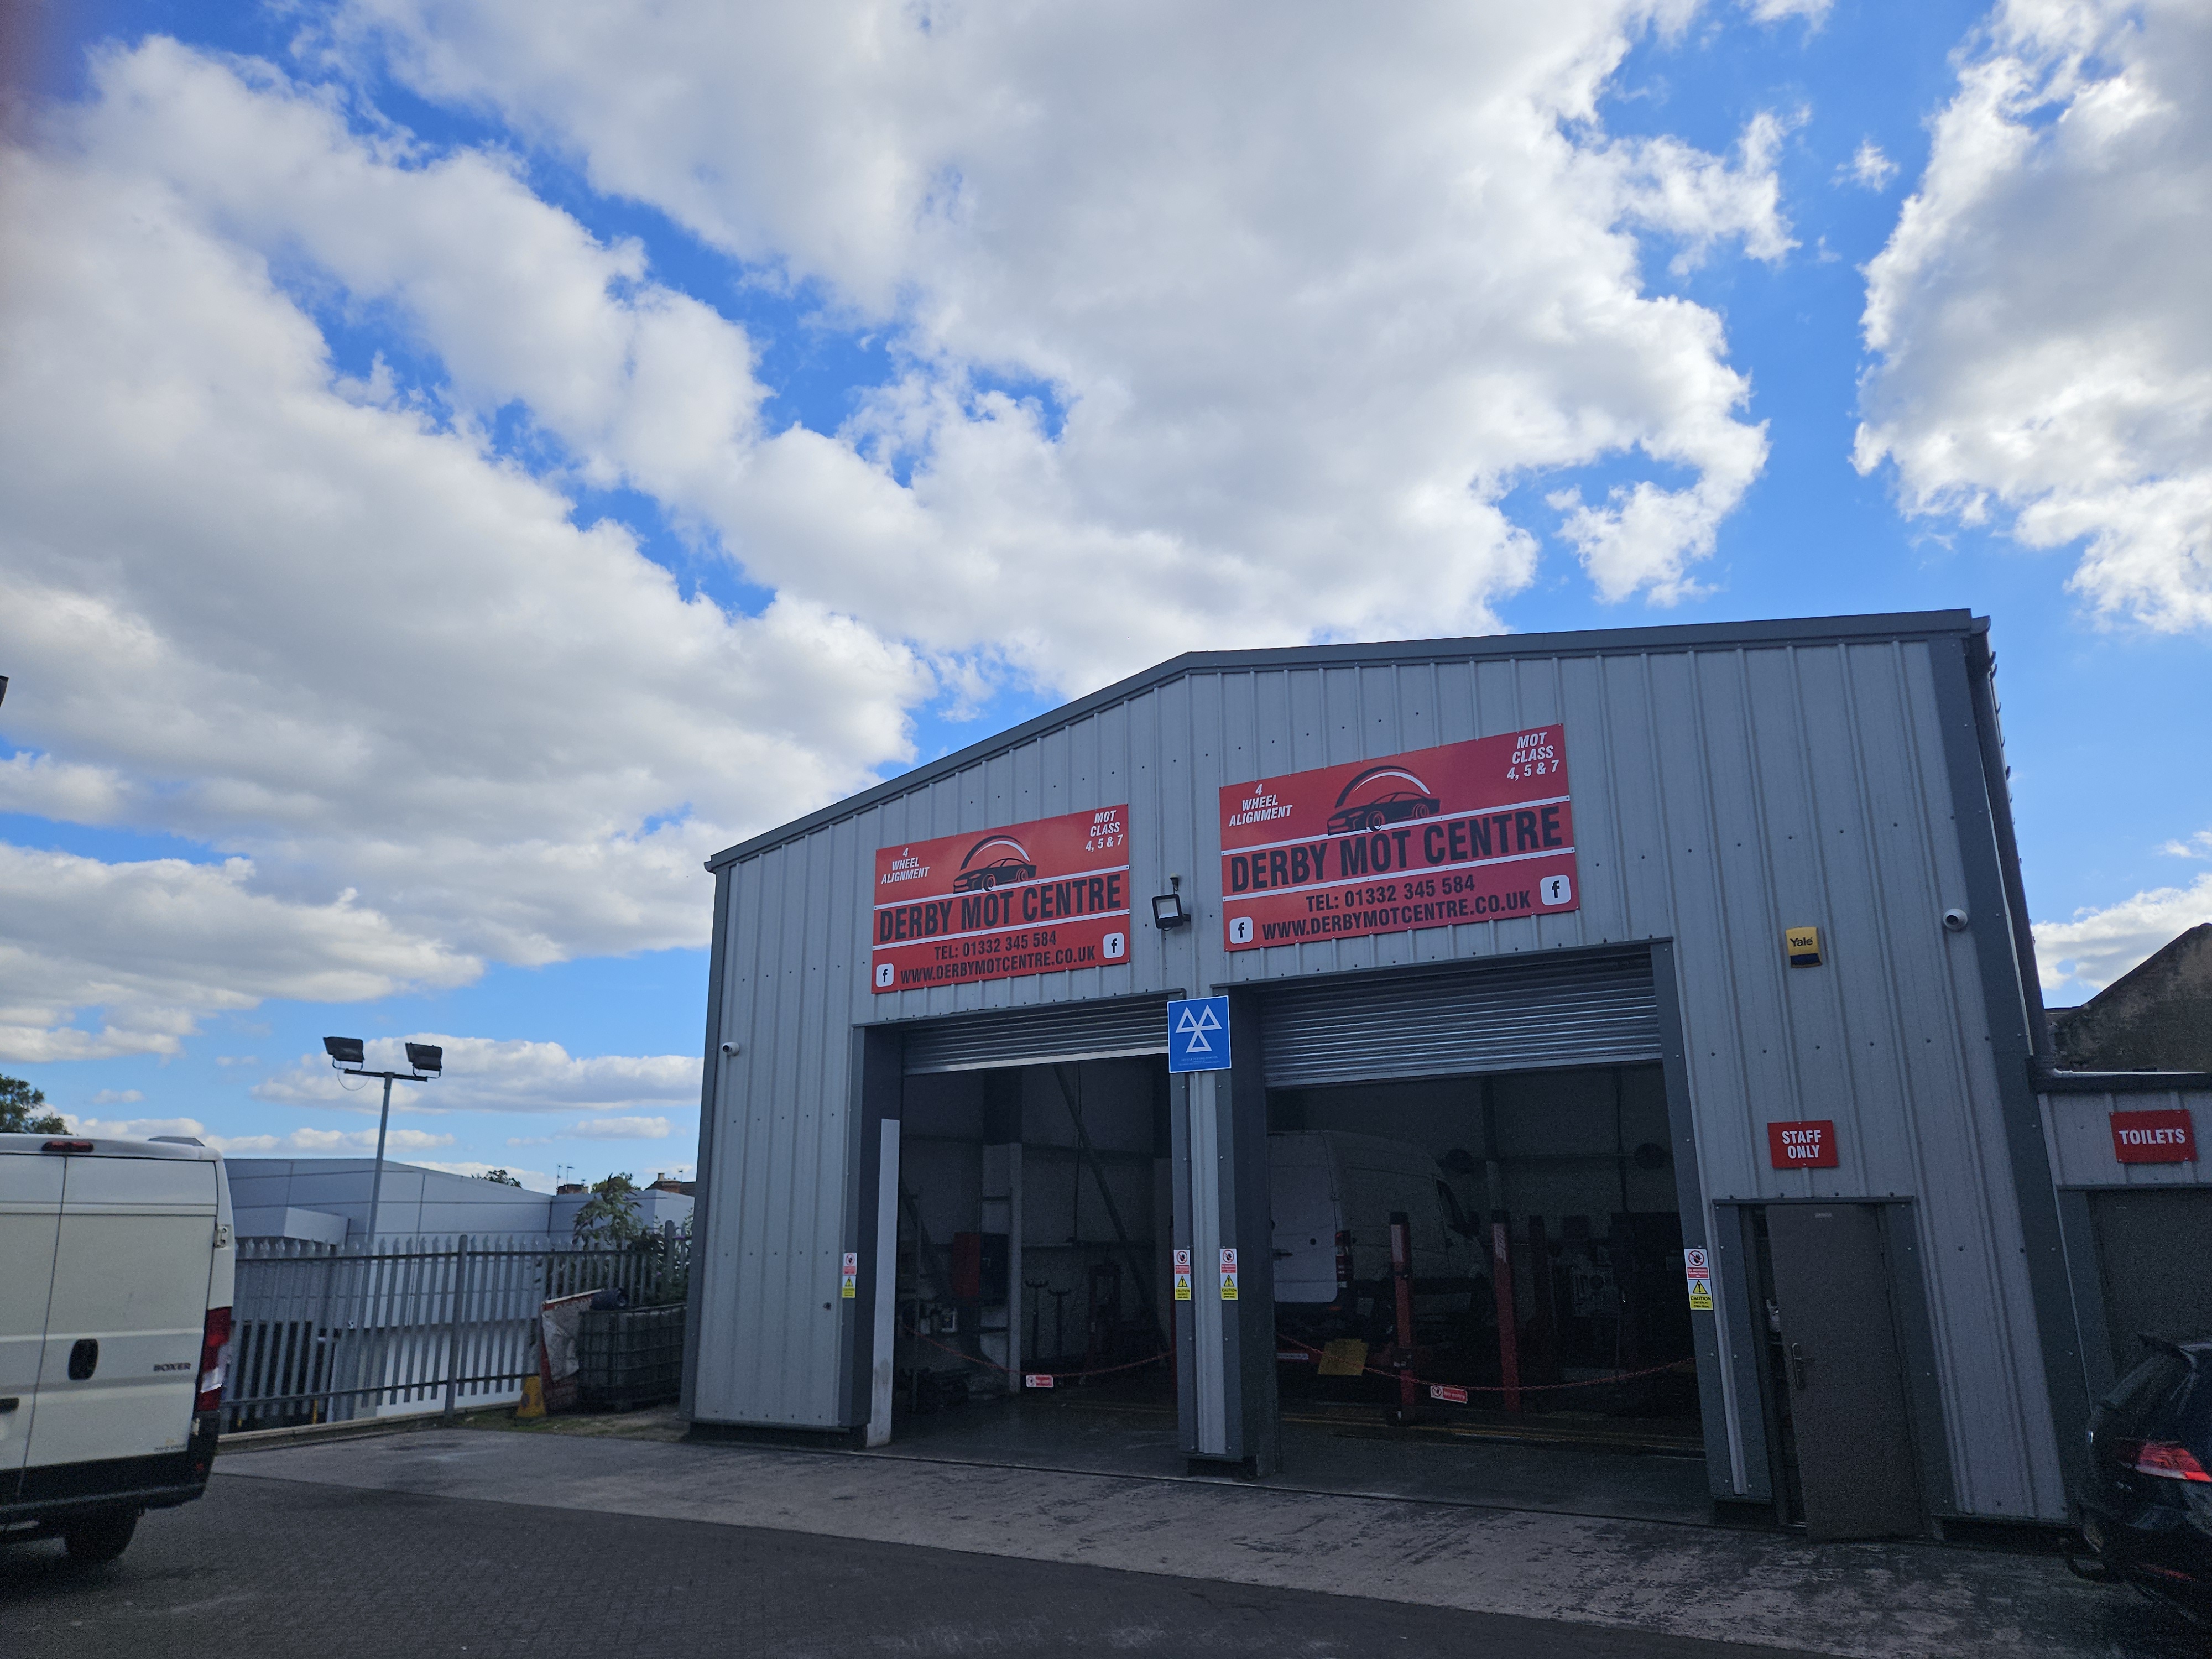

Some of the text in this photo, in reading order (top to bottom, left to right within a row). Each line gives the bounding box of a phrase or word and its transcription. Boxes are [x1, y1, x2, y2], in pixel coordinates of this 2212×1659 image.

[1517, 732, 1547, 749] MOT
[1512, 746, 1554, 764] CLASS
[1506, 759, 1559, 781] 4, 5 & 7
[1256, 784, 1262, 795] 4
[1241, 794, 1279, 811] WHEEL
[1094, 810, 1117, 823] MOT
[1229, 805, 1293, 827] ALIGNMENT
[1089, 822, 1120, 837] CLASS
[903, 848, 908, 857] 4
[1086, 835, 1123, 853] 4, 5 & 7
[1232, 806, 1563, 893] DERBY MOT CENTRE
[892, 857, 920, 870] WHEEL
[881, 867, 930, 884] ALIGNMENT
[1306, 874, 1475, 912] TEL: 01332 345 584
[880, 874, 1121, 942] DERBY MOT CENTRE
[1262, 890, 1531, 940] WWW.DERBYMOTCENTRE.CO.UK
[935, 931, 1056, 961] TEL: 01332 345 584
[1790, 937, 1813, 947] Yale
[901, 946, 1095, 984] WWW.DERBYMOTCENTRE.CO.UK
[1782, 1130, 1822, 1144] STAFF
[2119, 1129, 2186, 1145] TOILETS
[1787, 1145, 1820, 1159] ONLY
[154, 1362, 191, 1371] BOXER
